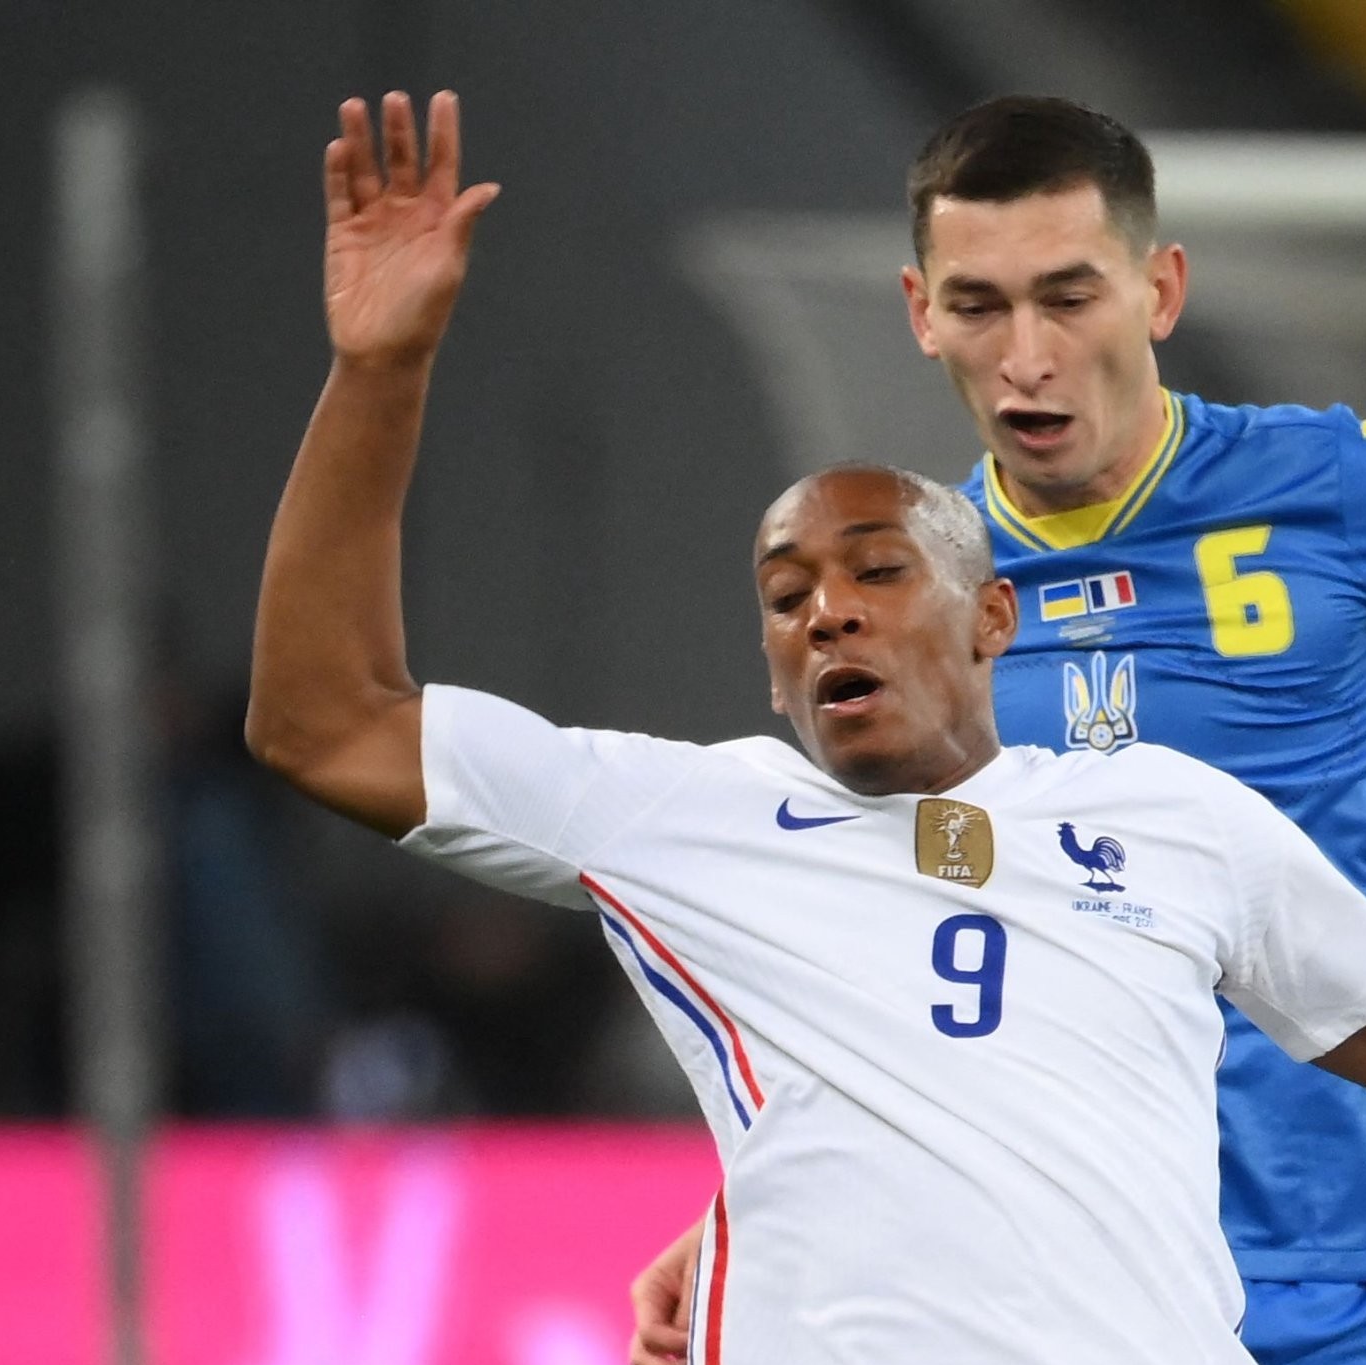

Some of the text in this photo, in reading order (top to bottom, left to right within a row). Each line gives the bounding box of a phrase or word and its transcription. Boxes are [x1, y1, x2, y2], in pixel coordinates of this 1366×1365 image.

[1193, 524, 1295, 658] 6
[938, 864, 973, 878] FIFA
[930, 914, 1007, 1038] 9
